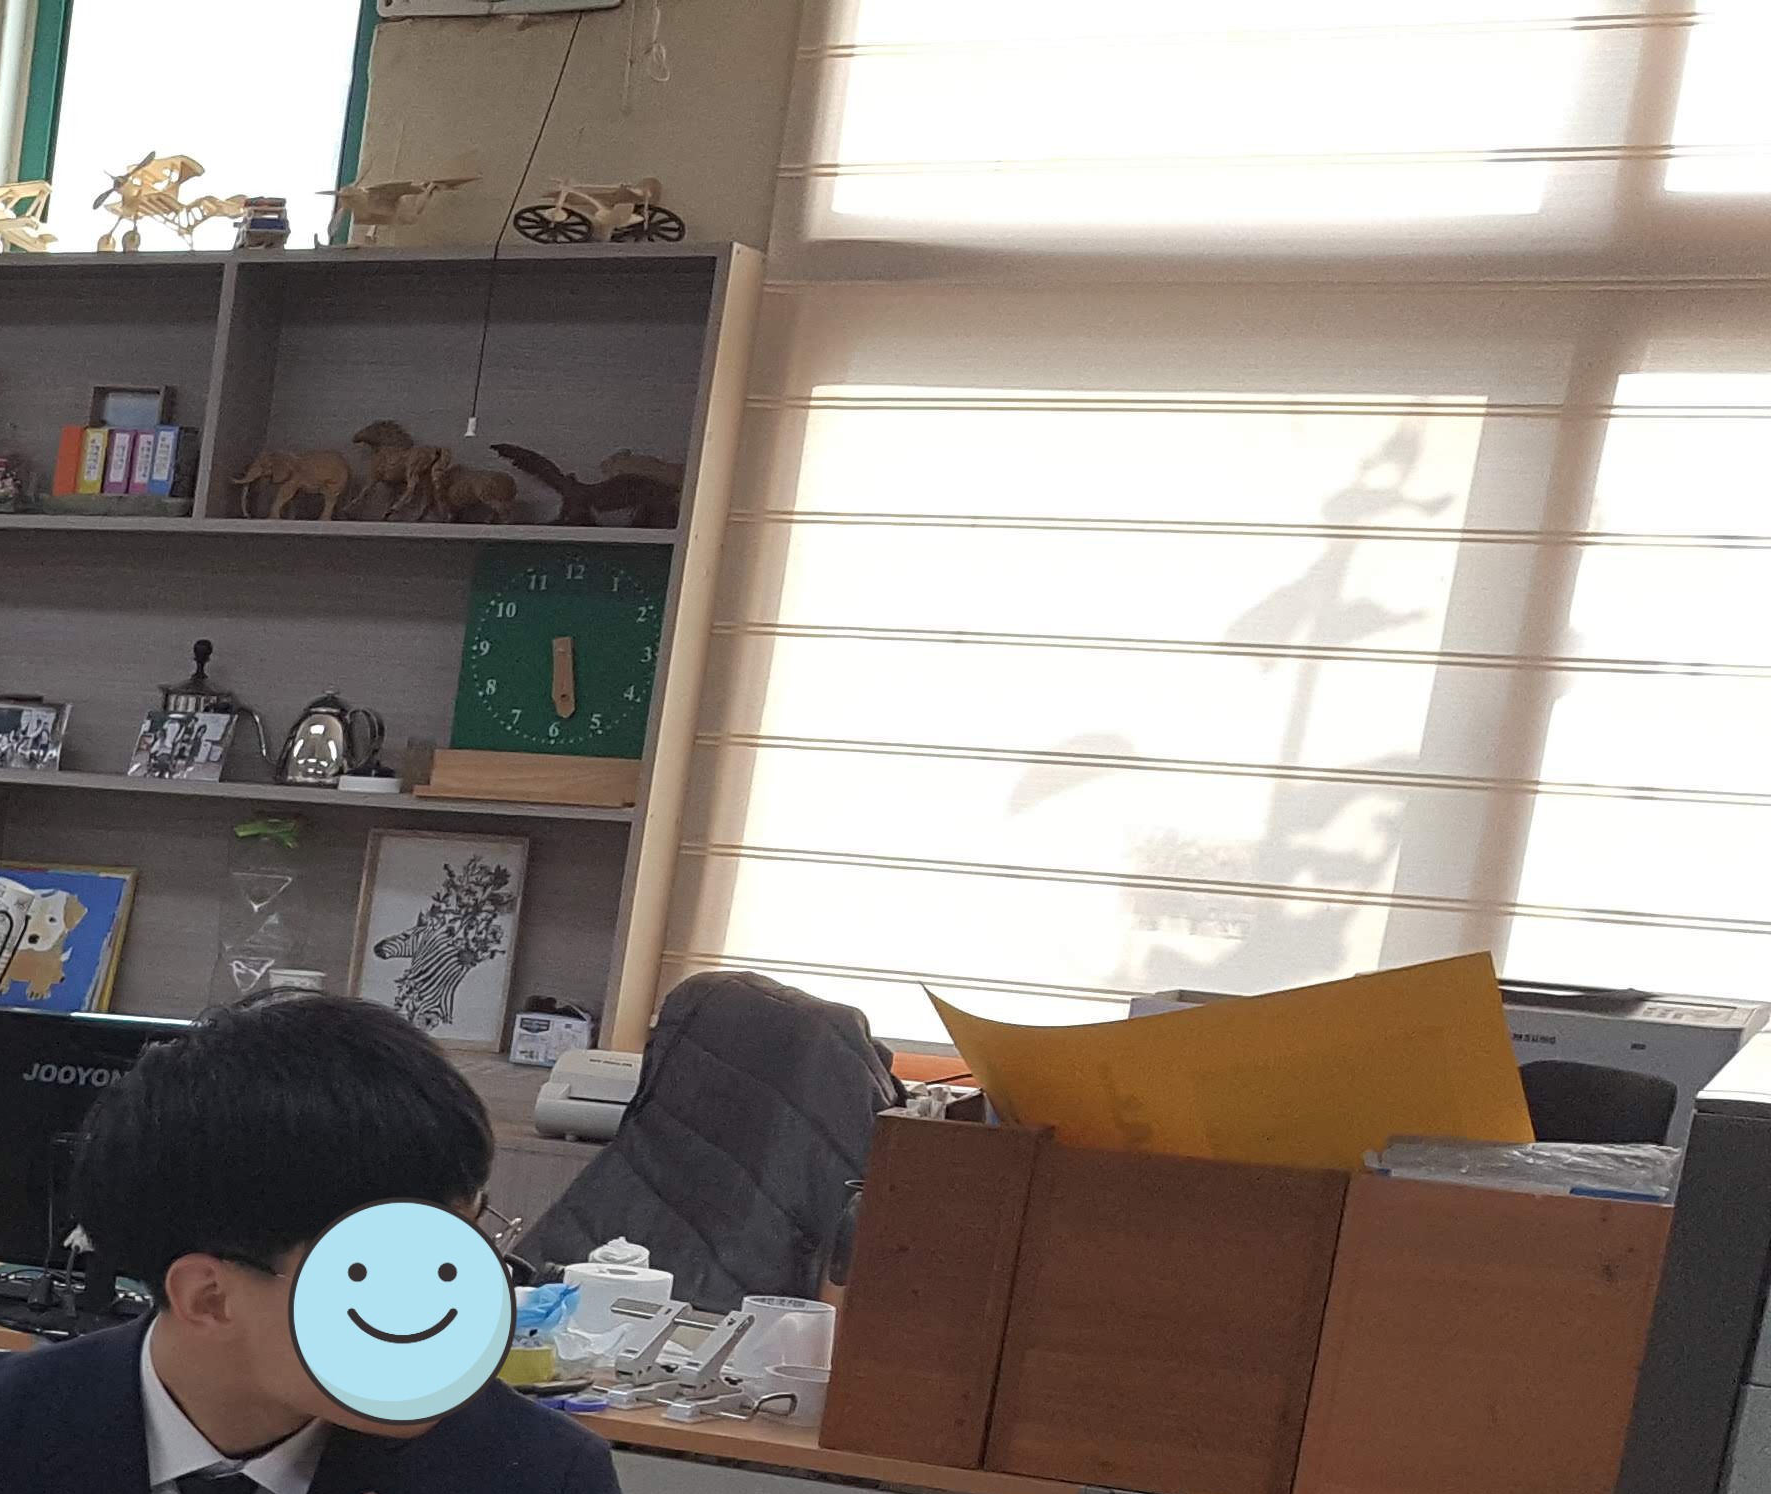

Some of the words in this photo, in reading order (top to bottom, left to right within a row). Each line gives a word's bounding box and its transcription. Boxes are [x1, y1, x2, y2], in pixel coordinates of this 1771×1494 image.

[565, 563, 585, 580] 12
[527, 573, 548, 590] 11
[611, 576, 620, 592] 1
[496, 602, 517, 618] 10
[636, 606, 647, 623] 2
[479, 640, 490, 656] 9
[641, 646, 652, 663] 3
[485, 679, 497, 696] 8
[623, 685, 635, 701] 4
[511, 709, 522, 725] 7
[590, 713, 602, 730] 5
[549, 721, 560, 738] 6
[1513, 1033, 1556, 1045] MSUNG
[22, 1062, 130, 1087] JOOYON
